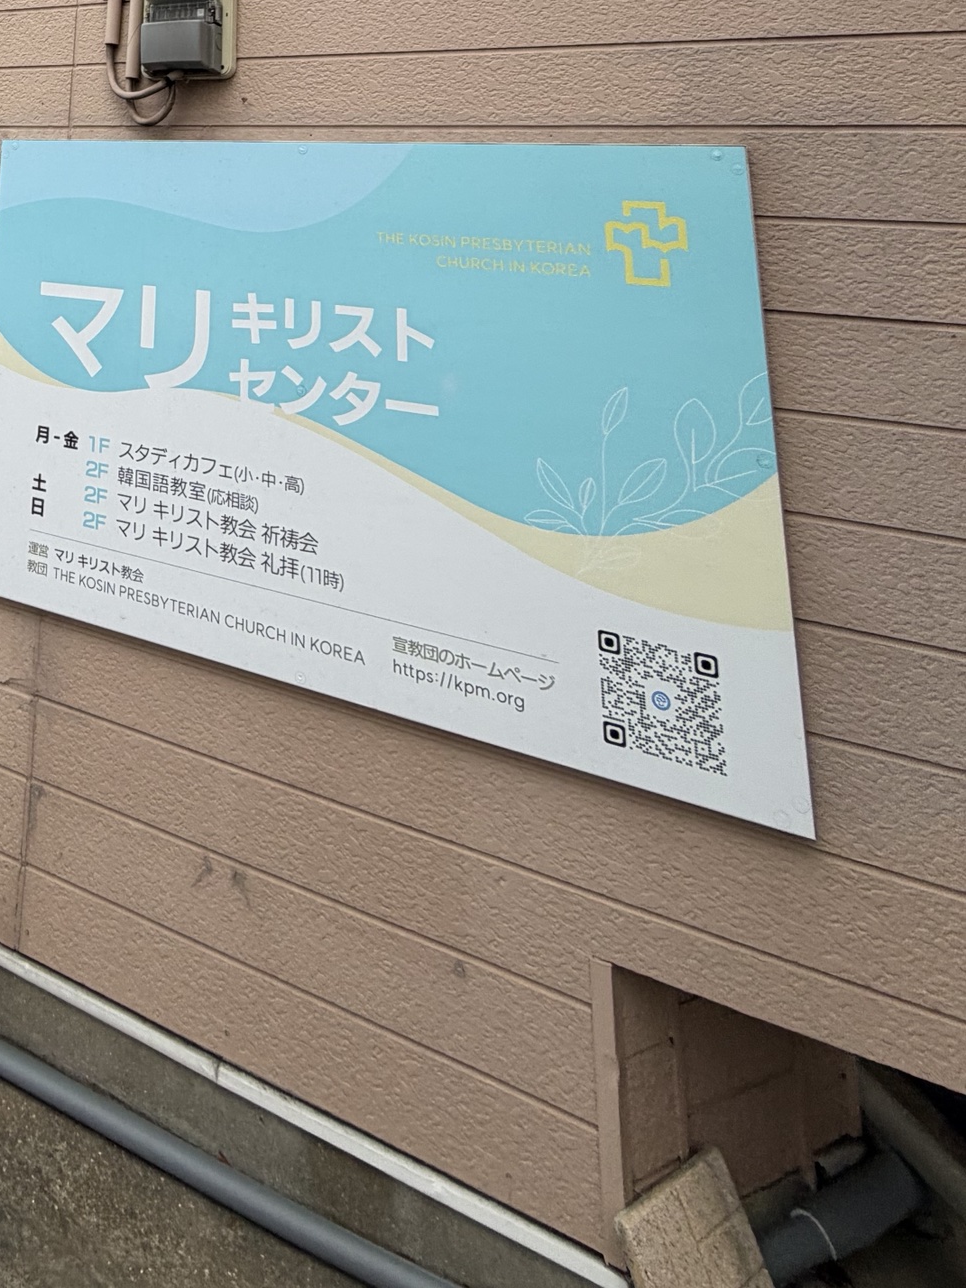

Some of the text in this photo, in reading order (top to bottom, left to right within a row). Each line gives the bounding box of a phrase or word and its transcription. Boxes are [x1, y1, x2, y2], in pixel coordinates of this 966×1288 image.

[377, 231, 591, 256] THE KOSIN PRESBYTERIAN
[436, 256, 591, 277] CHURCH IN KOREA
[40, 281, 211, 390] マリ
[232, 293, 435, 362] キリスト
[229, 358, 440, 426] センター
[88, 435, 110, 453] 1F
[32, 473, 319, 556] 土 2F マリ キリスト教会 祈祷会
[85, 460, 259, 514] 2F 韓国語教室(応相談)
[28, 541, 145, 584] 運営 マリ キリスト教会
[31, 496, 345, 593] 日 2F マリ キリスト教会 礼拝(11時)
[26, 559, 366, 666] 教団 THE KOSIN PRESBYTERIAN CHURCH IN KOREA
[392, 636, 556, 691] 宣教団のホームページ
[392, 658, 526, 713] https://kpm.org
